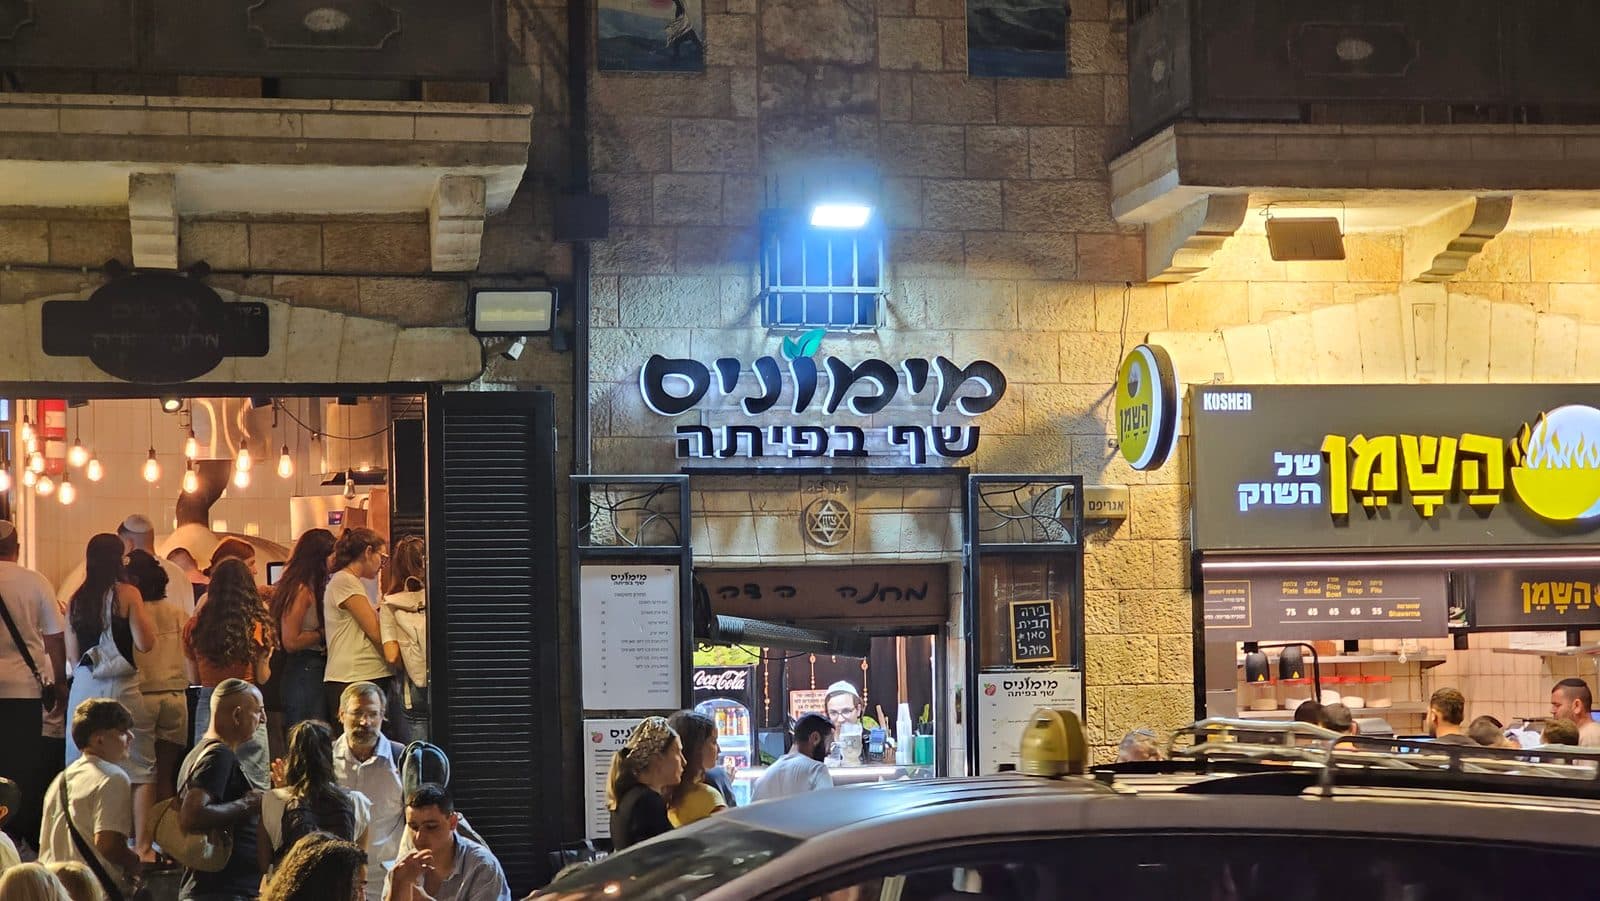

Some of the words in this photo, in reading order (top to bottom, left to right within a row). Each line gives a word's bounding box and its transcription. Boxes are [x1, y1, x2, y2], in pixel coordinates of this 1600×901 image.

[640, 354, 1007, 416] מימוניס
[1203, 392, 1252, 411] KOSHER
[675, 425, 869, 459] בפיתה
[888, 425, 980, 465] שף
[1274, 452, 1322, 477] של
[1238, 482, 1322, 512] השוק
[1020, 605, 1050, 617] בירה
[1285, 608, 1297, 616] 75
[1308, 608, 1319, 616] 65
[1329, 608, 1340, 616] 65
[1350, 607, 1361, 615] 65
[1371, 607, 1383, 615] 55
[1016, 618, 1049, 629] חבית
[1027, 631, 1046, 641] סאן
[1003, 678, 1058, 691] מימוניס
